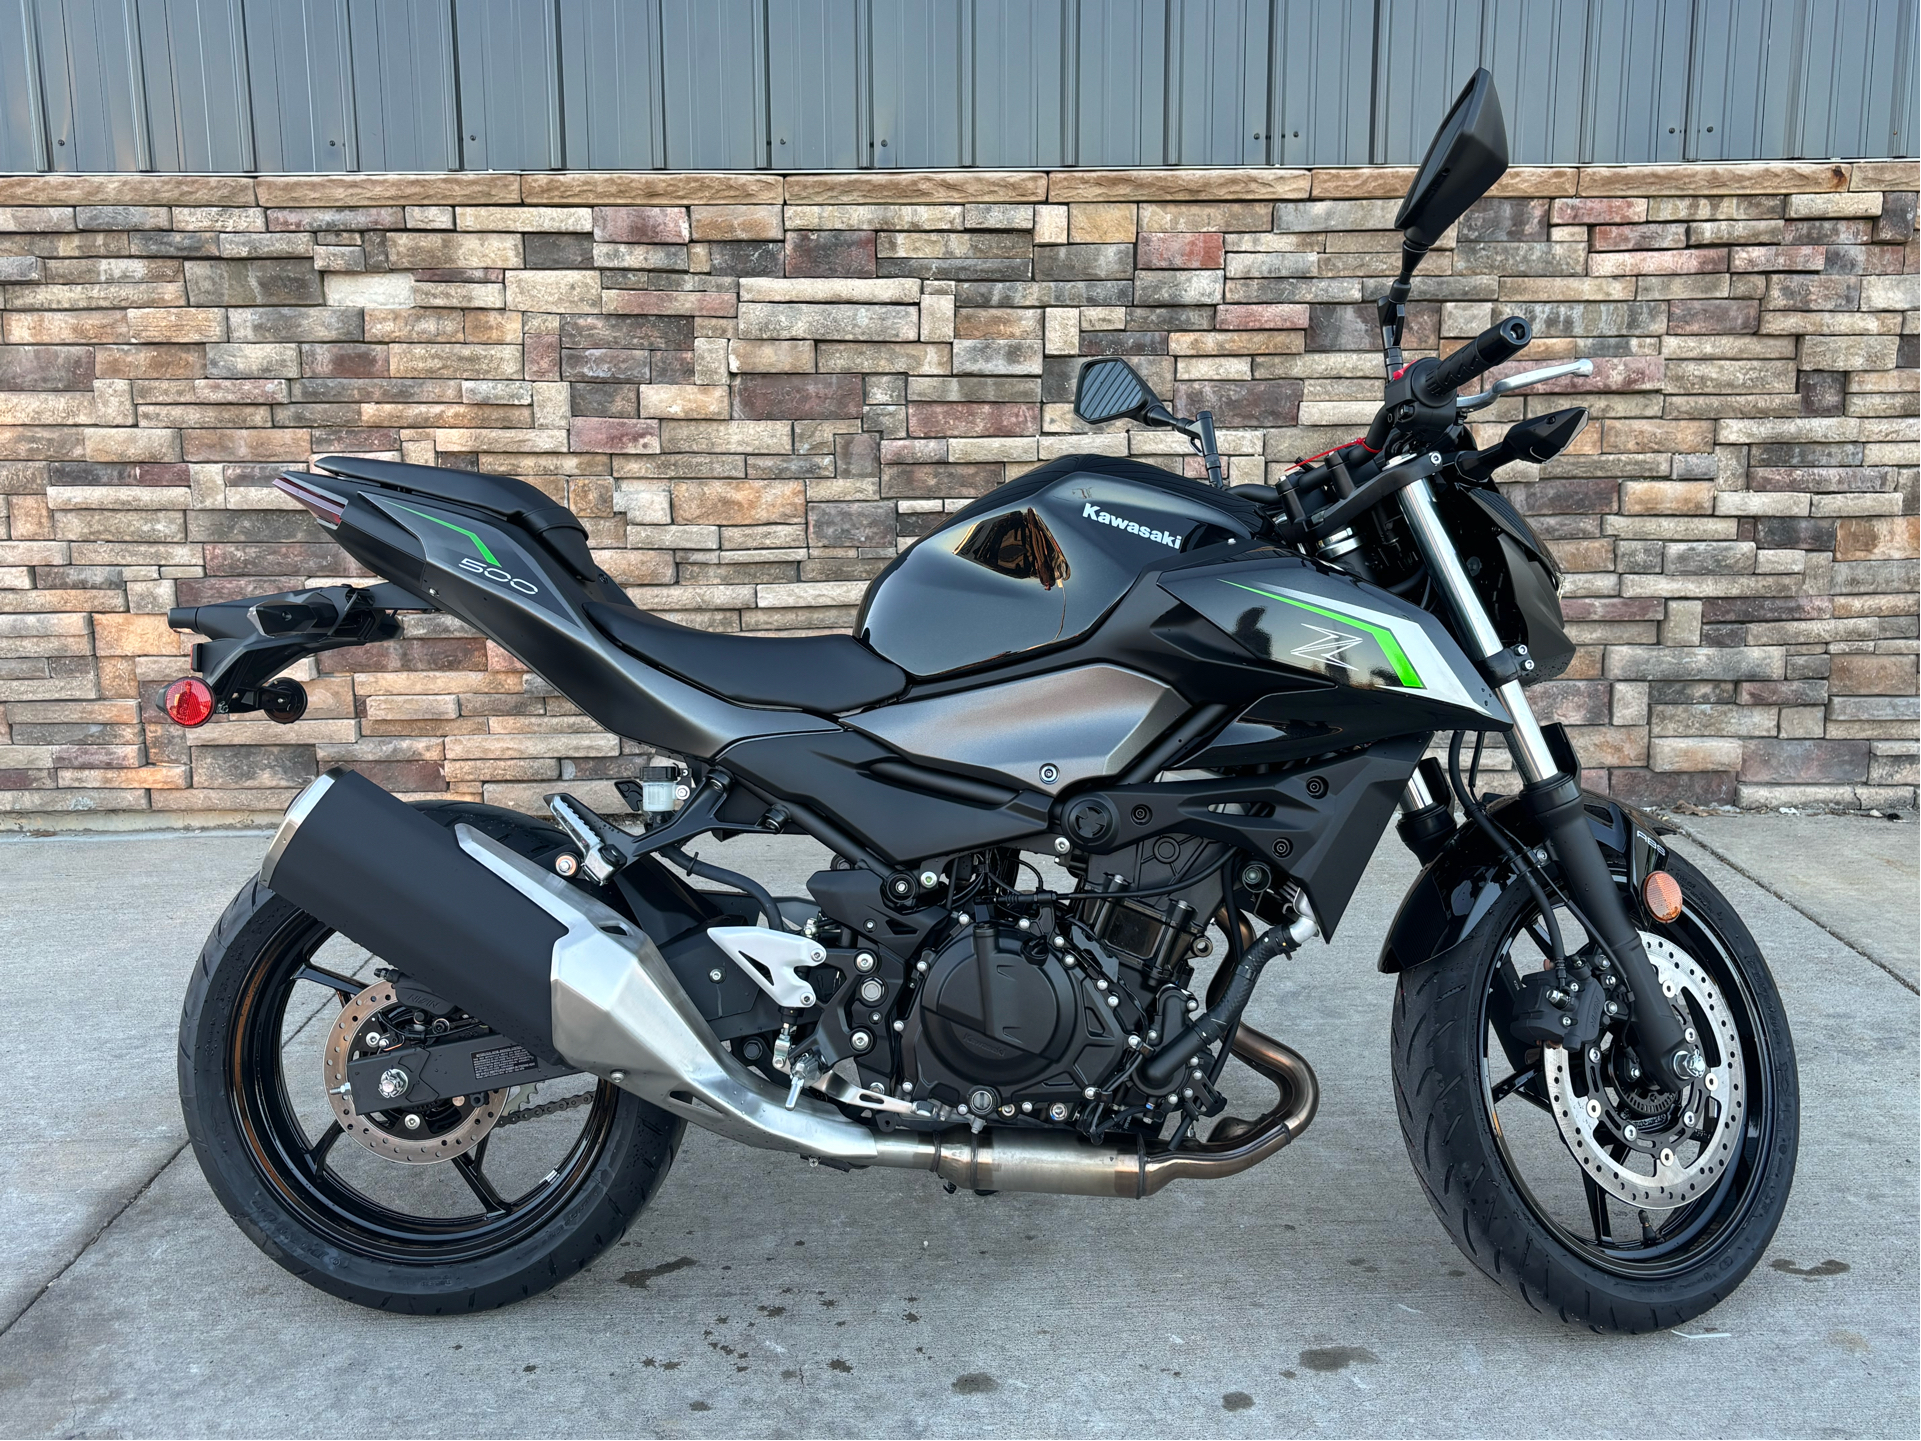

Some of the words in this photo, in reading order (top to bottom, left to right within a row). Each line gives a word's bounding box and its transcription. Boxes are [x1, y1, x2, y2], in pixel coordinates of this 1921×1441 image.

[1082, 502, 1182, 550] Kawasaki
[458, 557, 539, 595] 500
[1636, 830, 1666, 857] ABS
